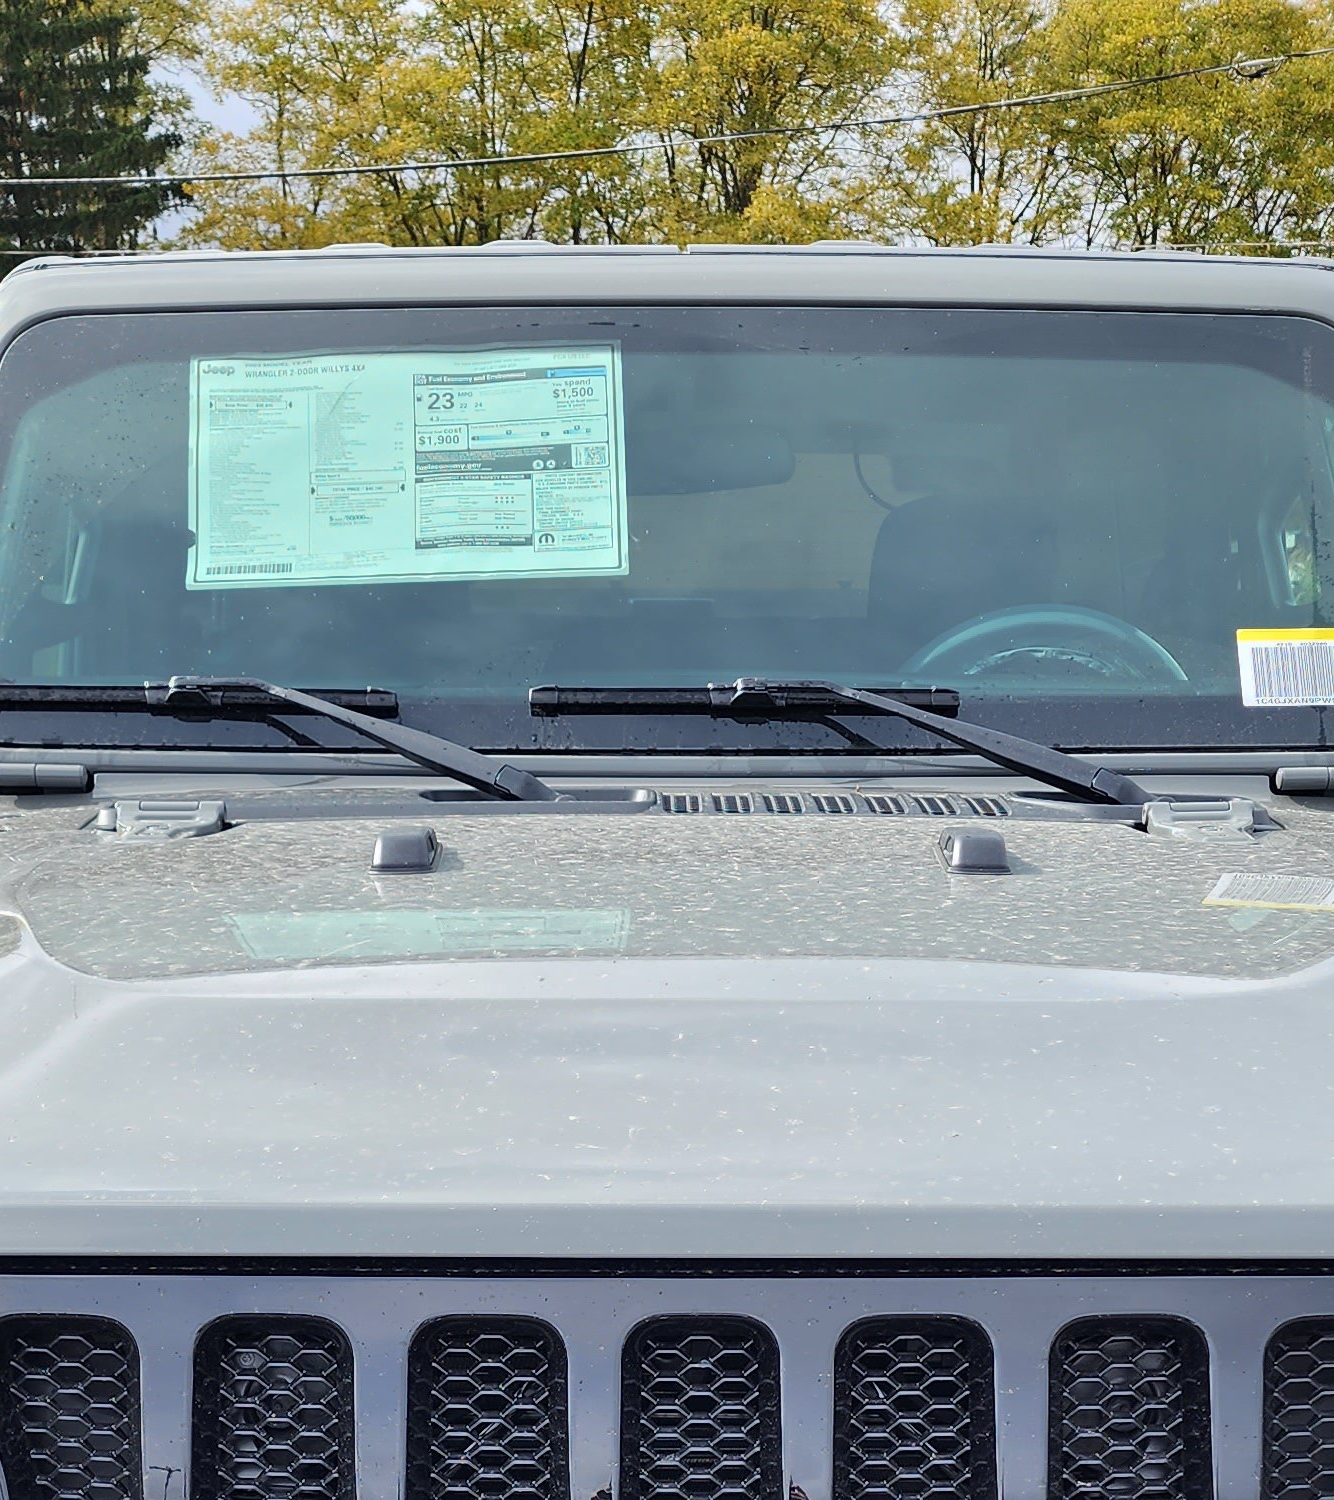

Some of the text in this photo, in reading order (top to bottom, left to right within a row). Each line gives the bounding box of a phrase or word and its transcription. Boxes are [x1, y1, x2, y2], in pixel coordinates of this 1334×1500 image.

[202, 364, 236, 377] Jeep
[244, 369, 289, 379] WRANGLER
[290, 366, 319, 376] 2-DOOR
[320, 364, 350, 374] WILLYS
[428, 371, 527, 385] Fuel Economy and Environment
[564, 379, 592, 389] spend
[553, 387, 594, 400] $1,500
[427, 392, 455, 410] 23
[418, 435, 461, 447] $1,900
